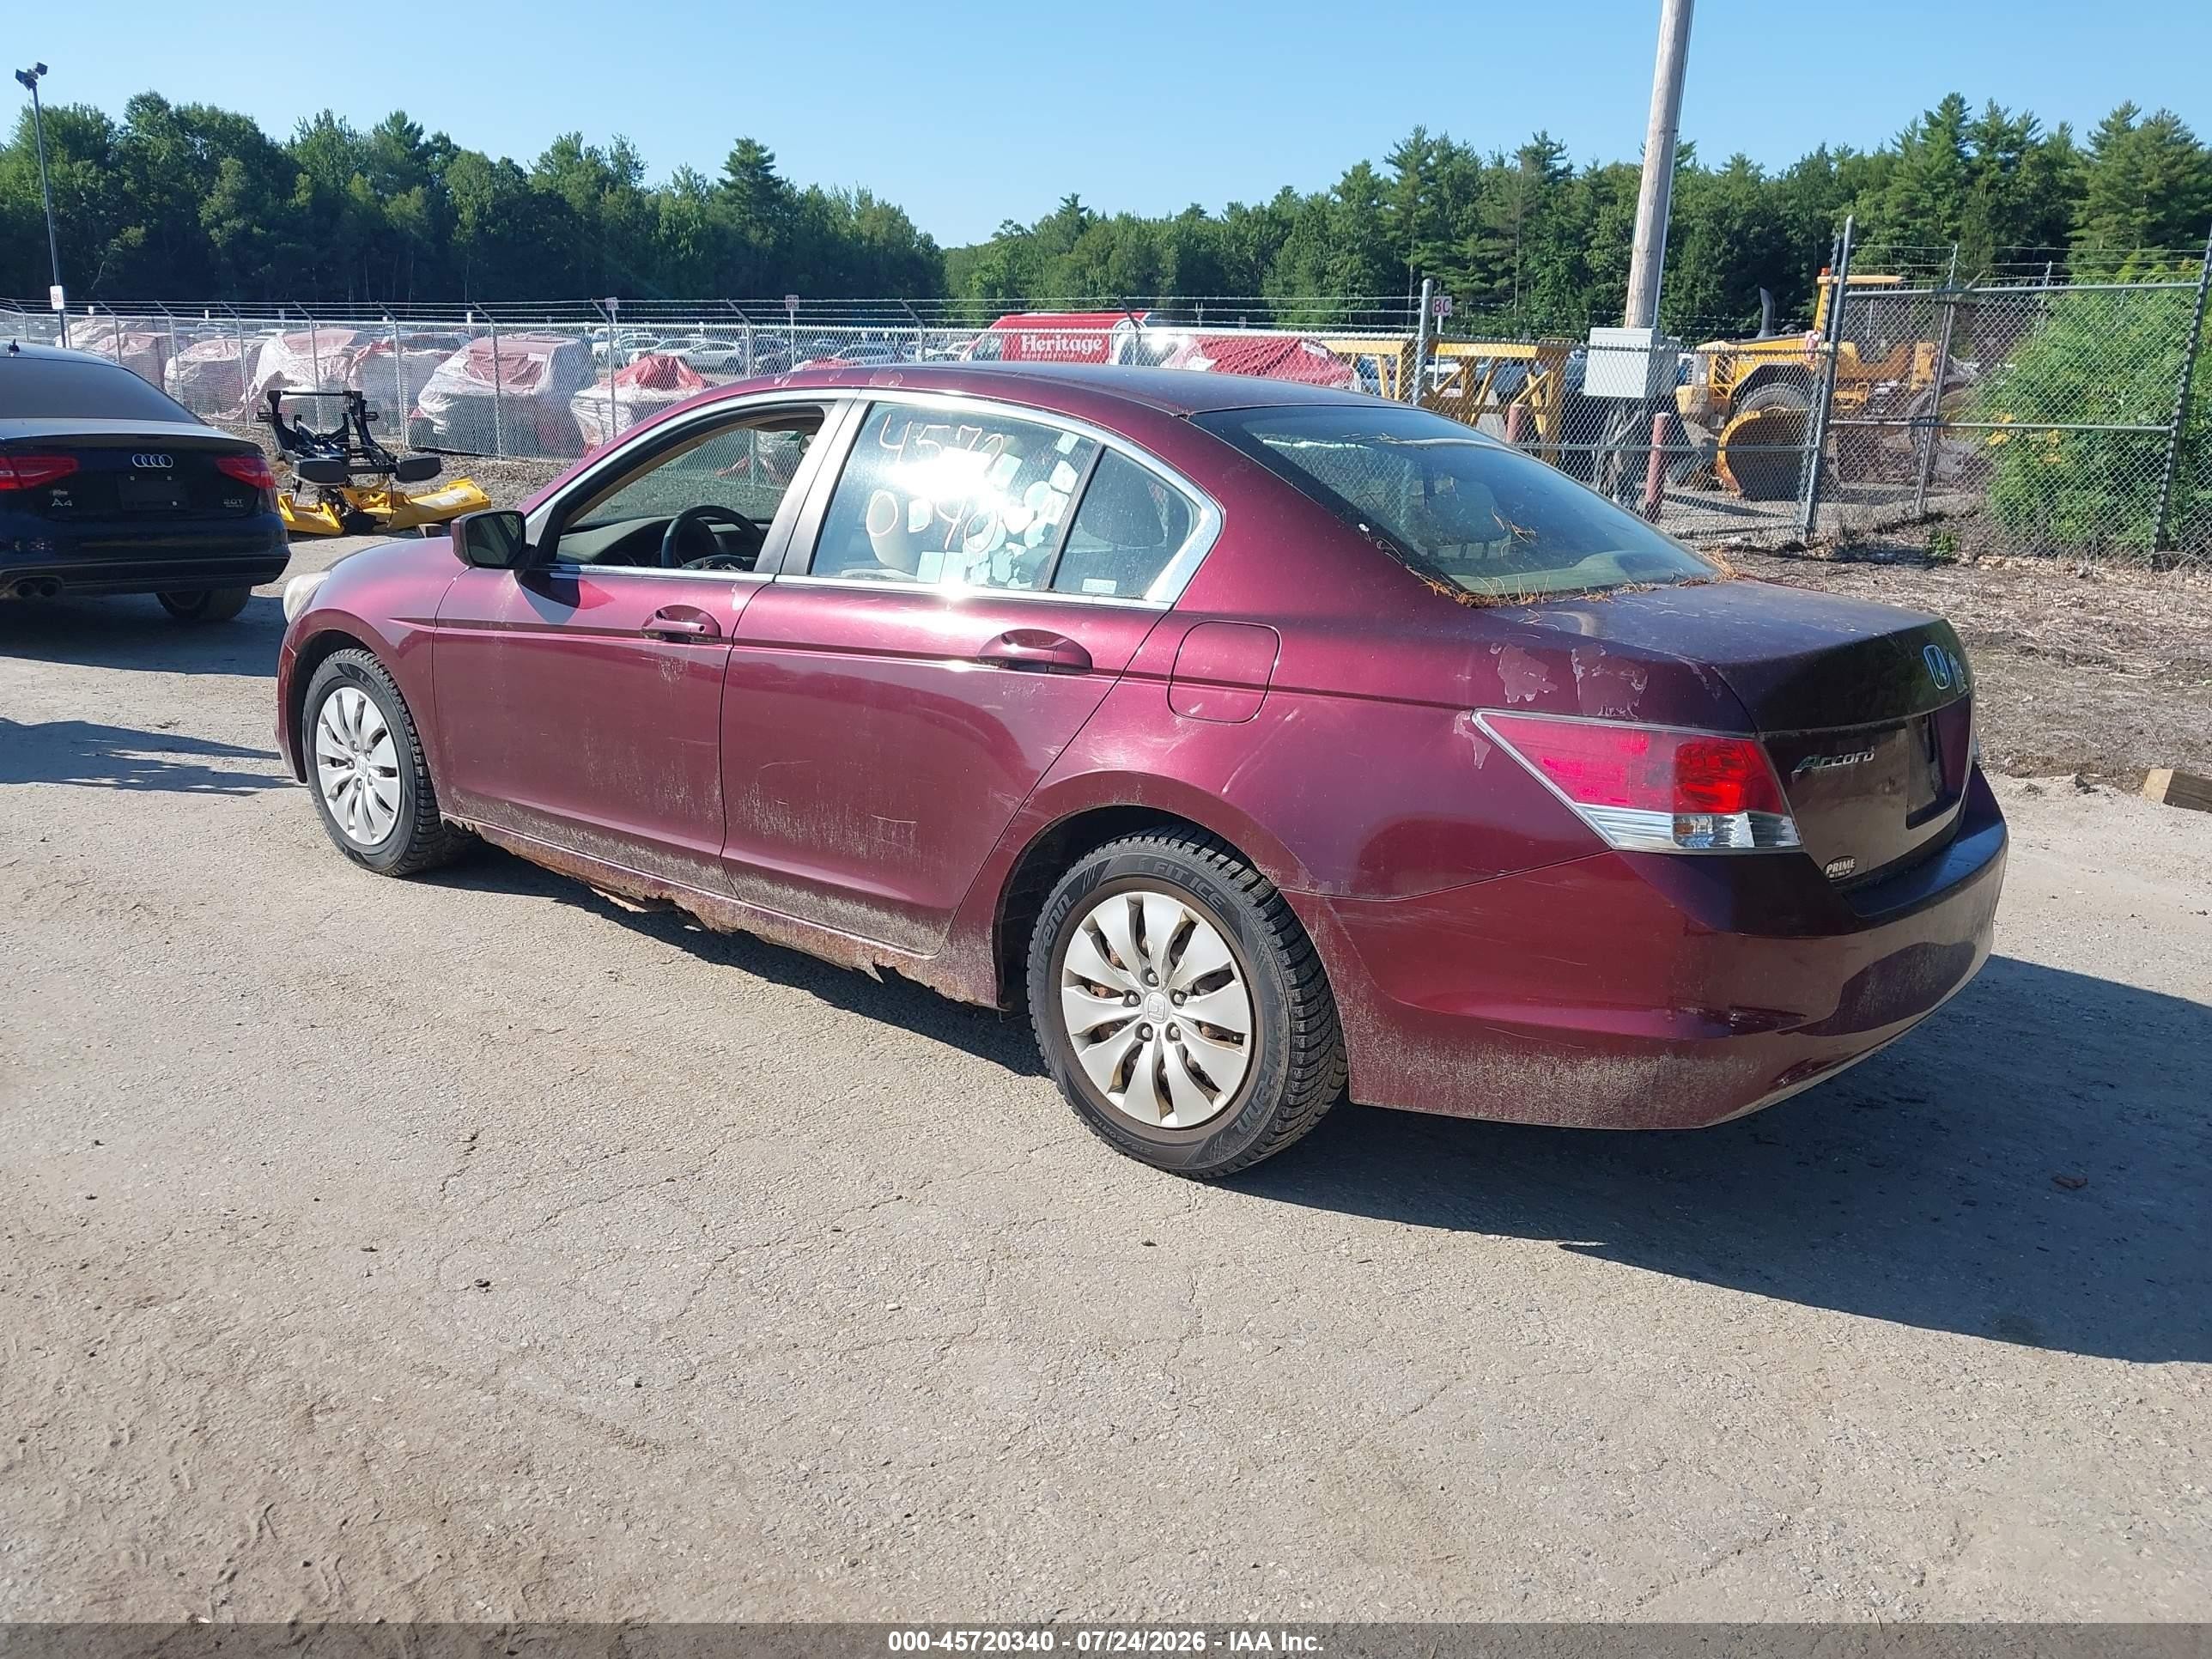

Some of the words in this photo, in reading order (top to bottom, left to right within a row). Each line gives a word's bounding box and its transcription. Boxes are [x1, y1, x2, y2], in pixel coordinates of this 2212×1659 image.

[1021, 333, 1103, 355] Heritage
[52, 497, 73, 507] A4
[1791, 745, 1875, 775] Accord
[1826, 859, 1856, 875] PRIME
[1152, 861, 1189, 881] FIT
[1189, 876, 1226, 908] ICE
